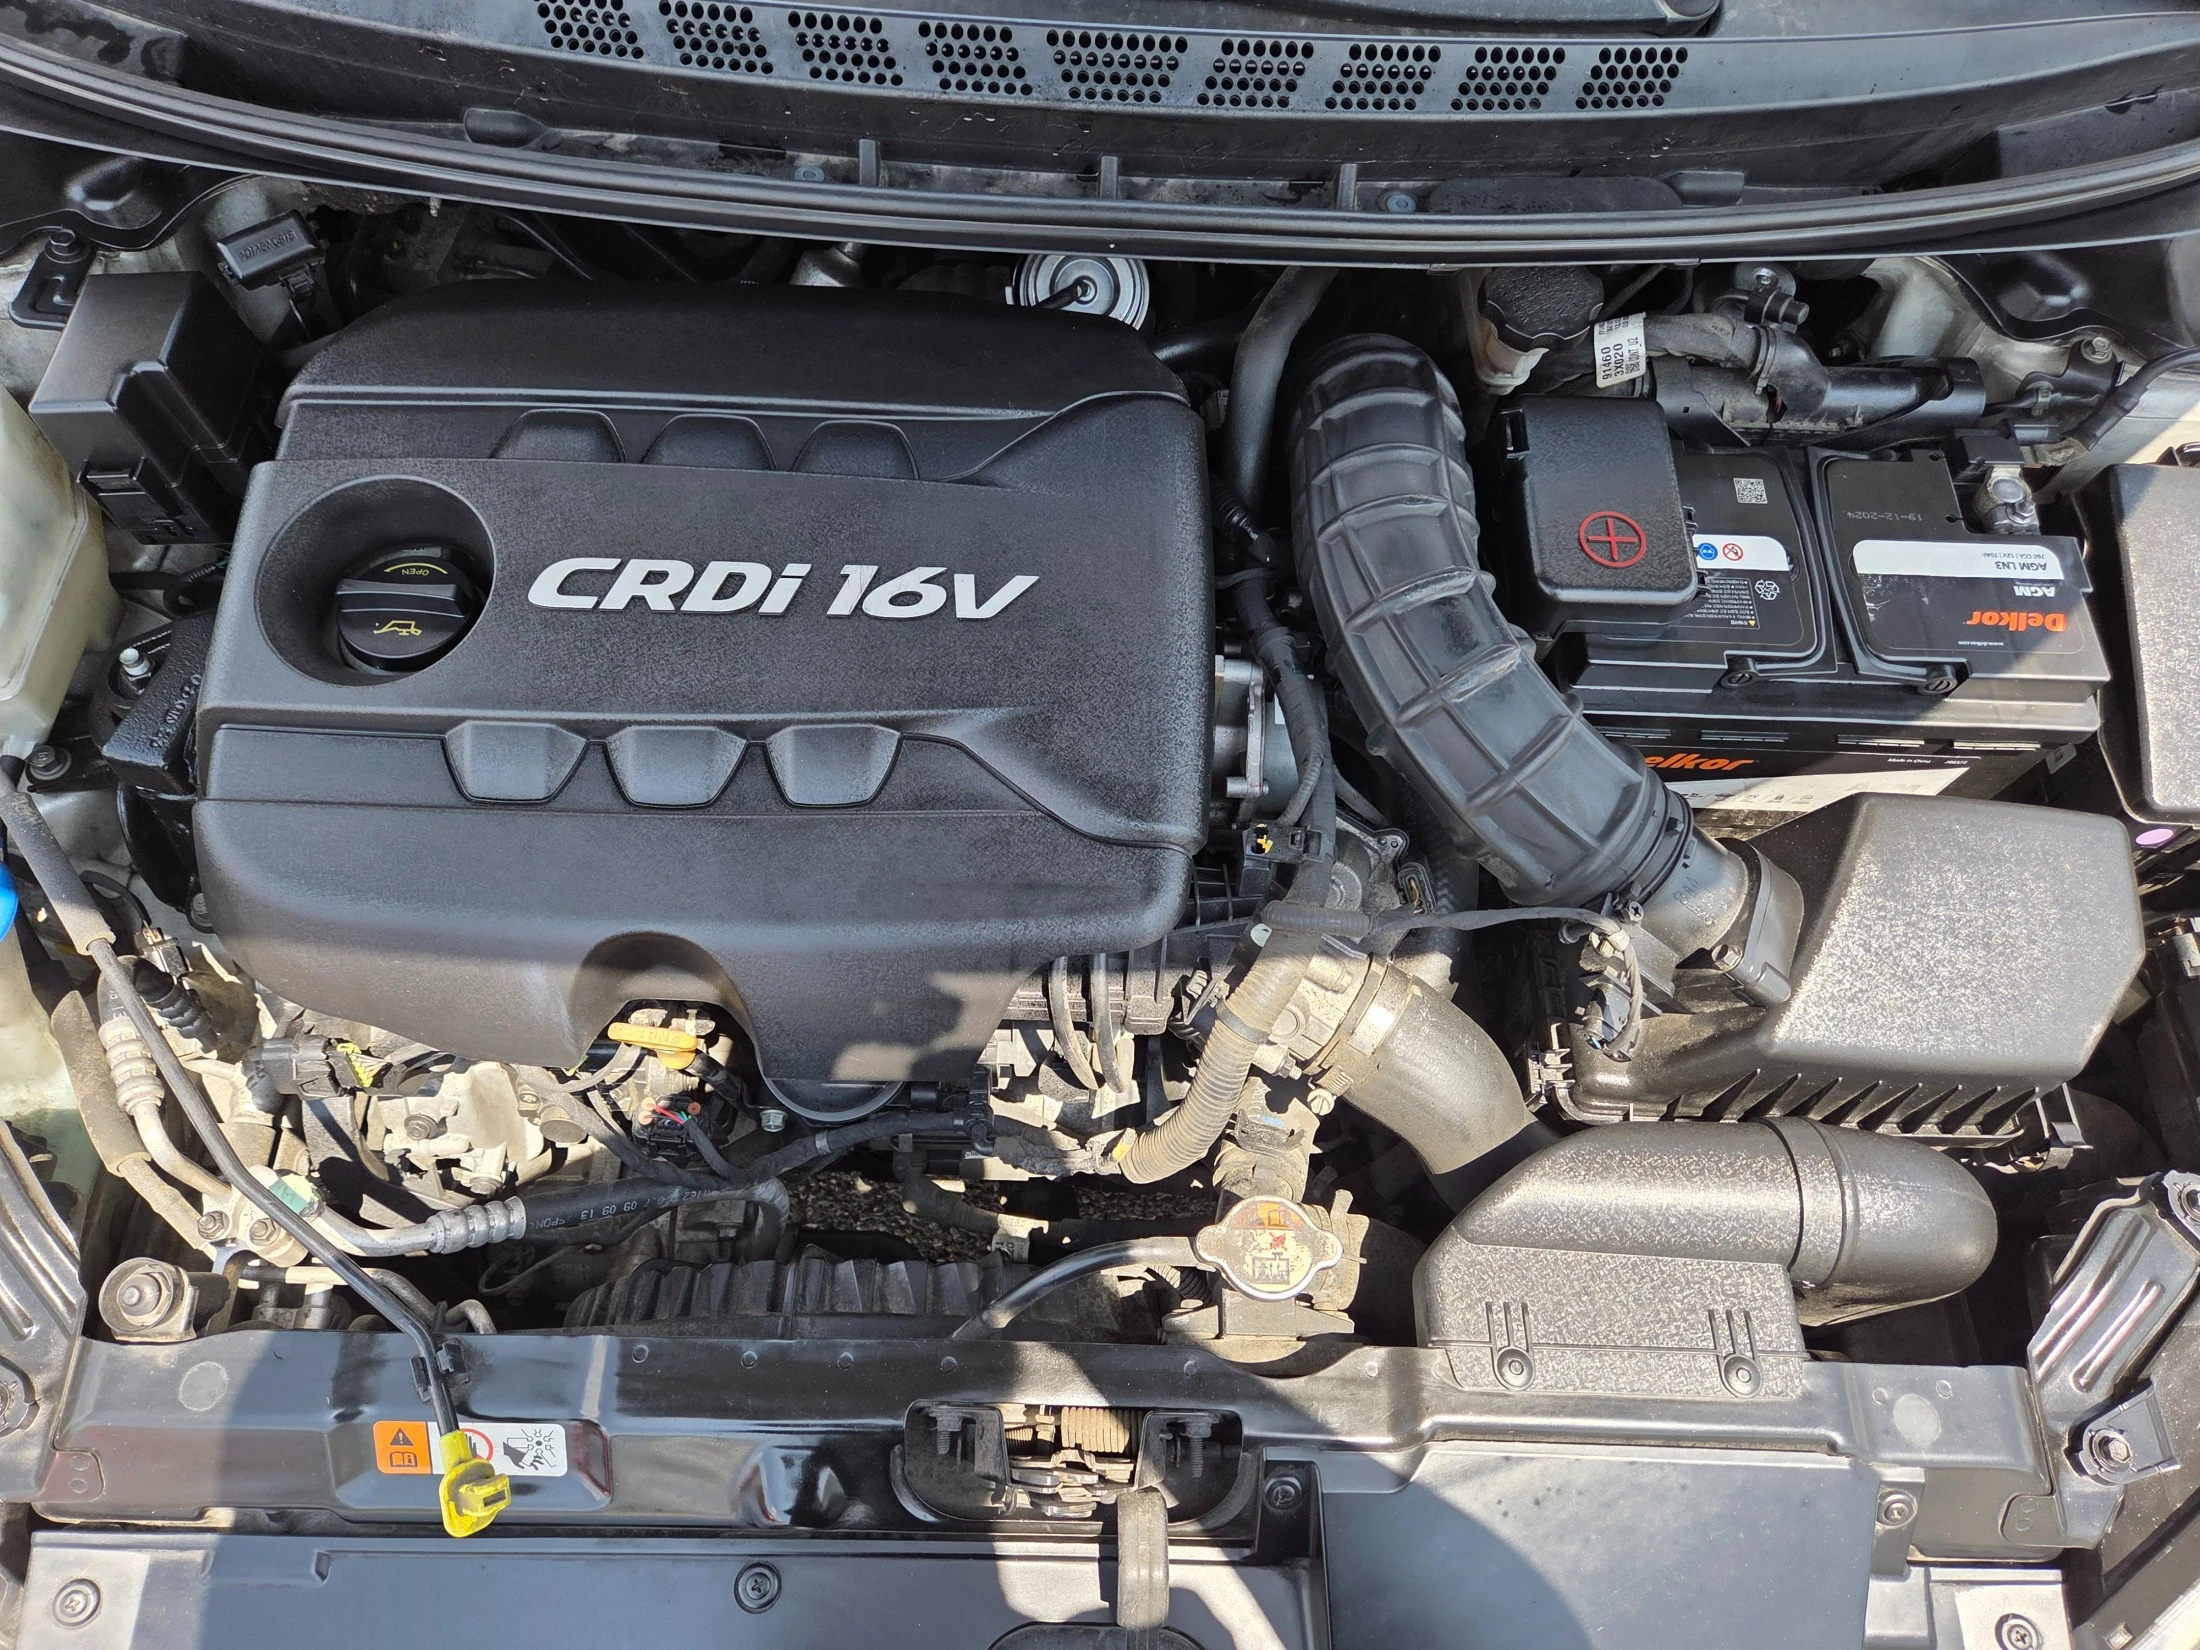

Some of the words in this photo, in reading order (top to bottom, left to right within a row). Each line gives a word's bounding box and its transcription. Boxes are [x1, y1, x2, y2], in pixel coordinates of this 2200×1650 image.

[1600, 346, 1612, 380] 91460
[1612, 343, 1624, 377] 3X020
[401, 567, 430, 577] OPEN
[1994, 561, 2017, 570] LN3
[2018, 562, 2047, 571] AGM
[527, 557, 812, 616] CRDi
[826, 564, 1040, 619] 16V
[2013, 586, 2055, 597] AGM
[1966, 610, 2067, 633] Delkor
[1644, 753, 1754, 770] elkor
[580, 1208, 594, 1220] 13
